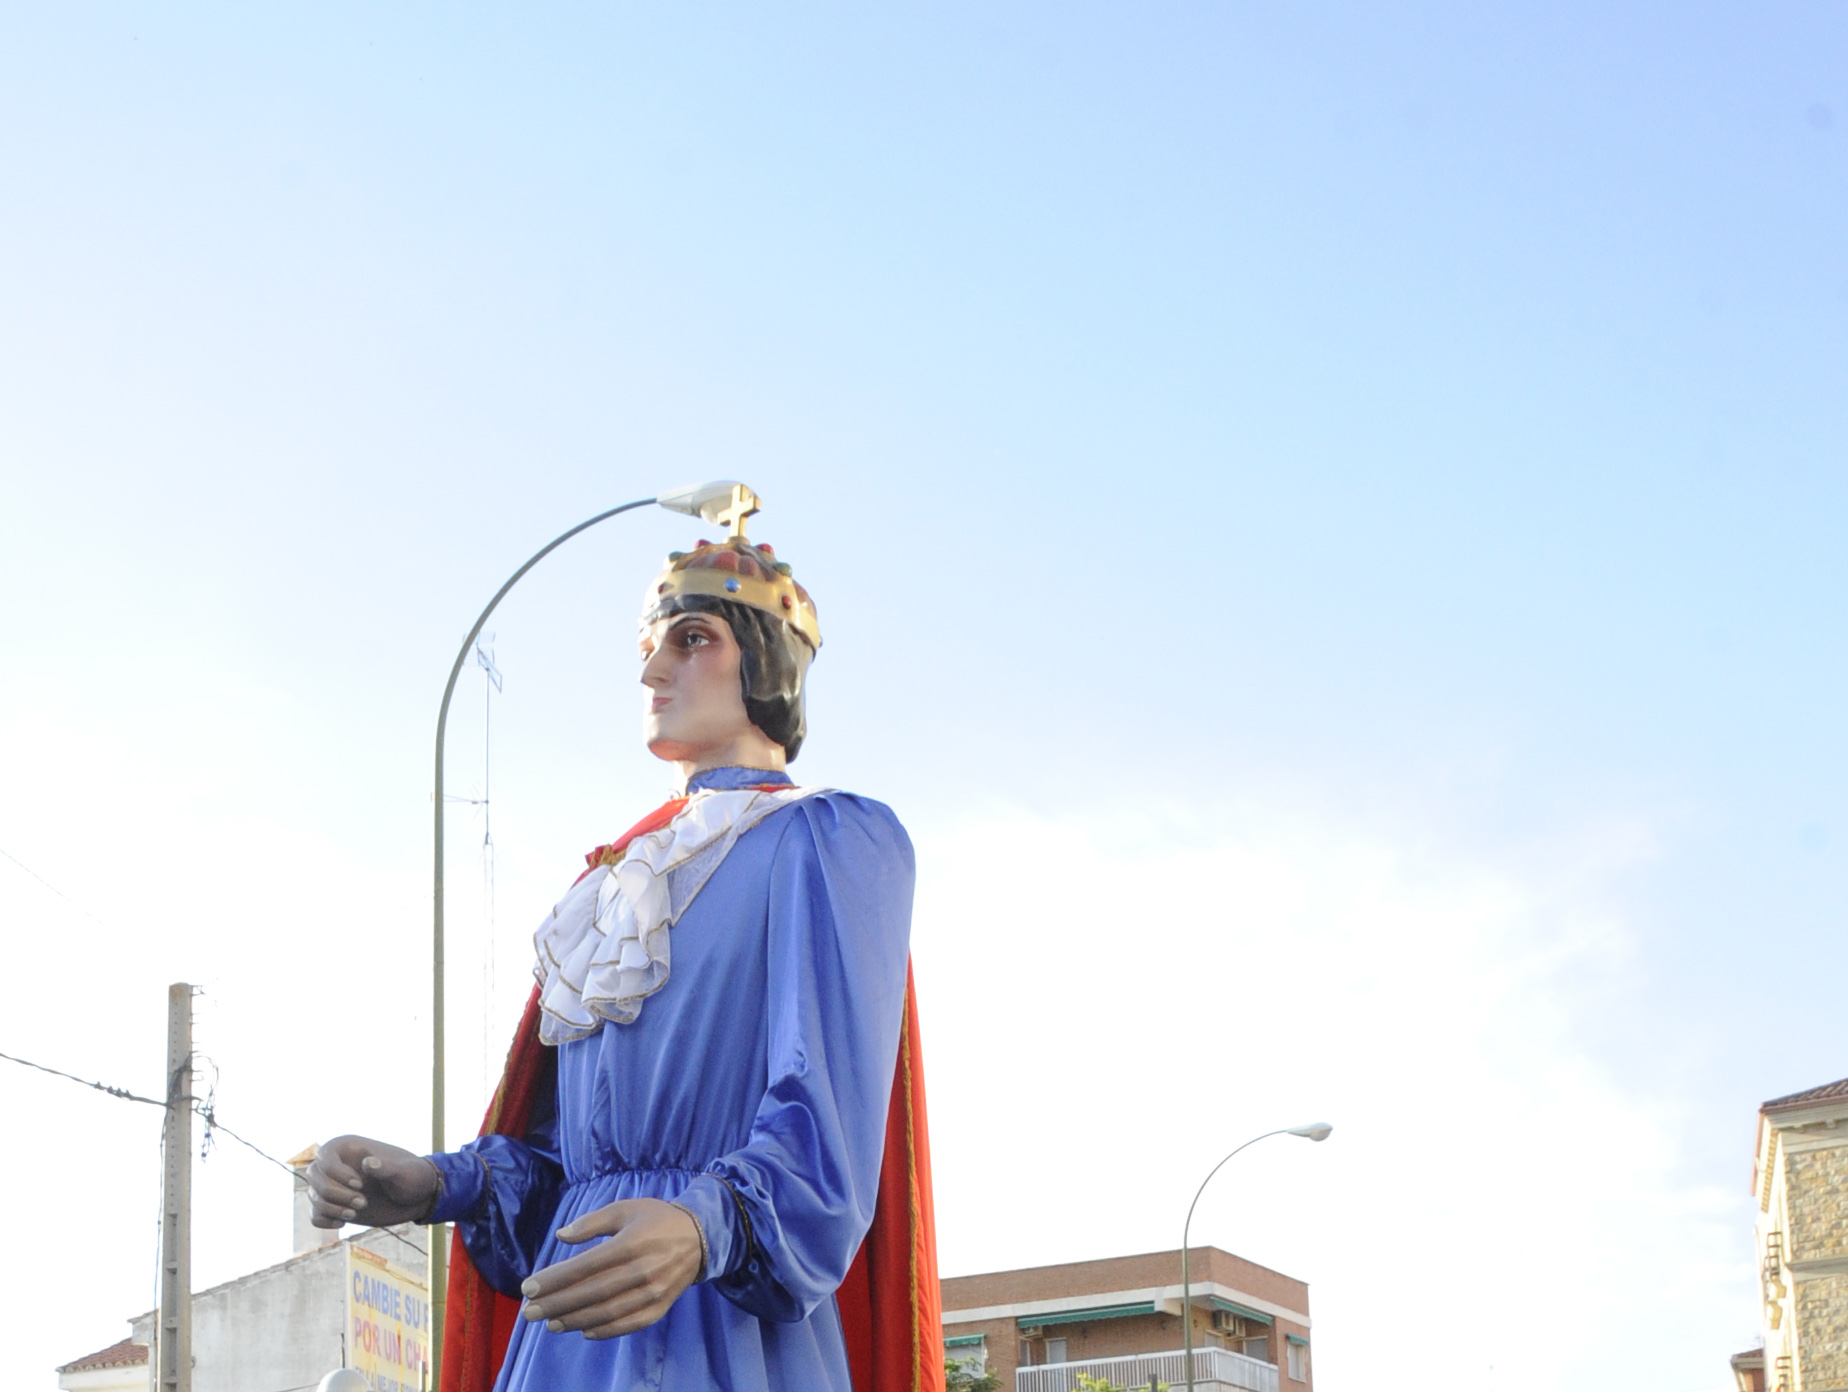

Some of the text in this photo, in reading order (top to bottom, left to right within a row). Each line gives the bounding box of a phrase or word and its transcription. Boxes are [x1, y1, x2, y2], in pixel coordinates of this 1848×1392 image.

[353, 1270, 401, 1322] CAMBIE
[404, 1294, 420, 1329] SU
[354, 1316, 381, 1357] POR
[384, 1329, 402, 1366] UN
